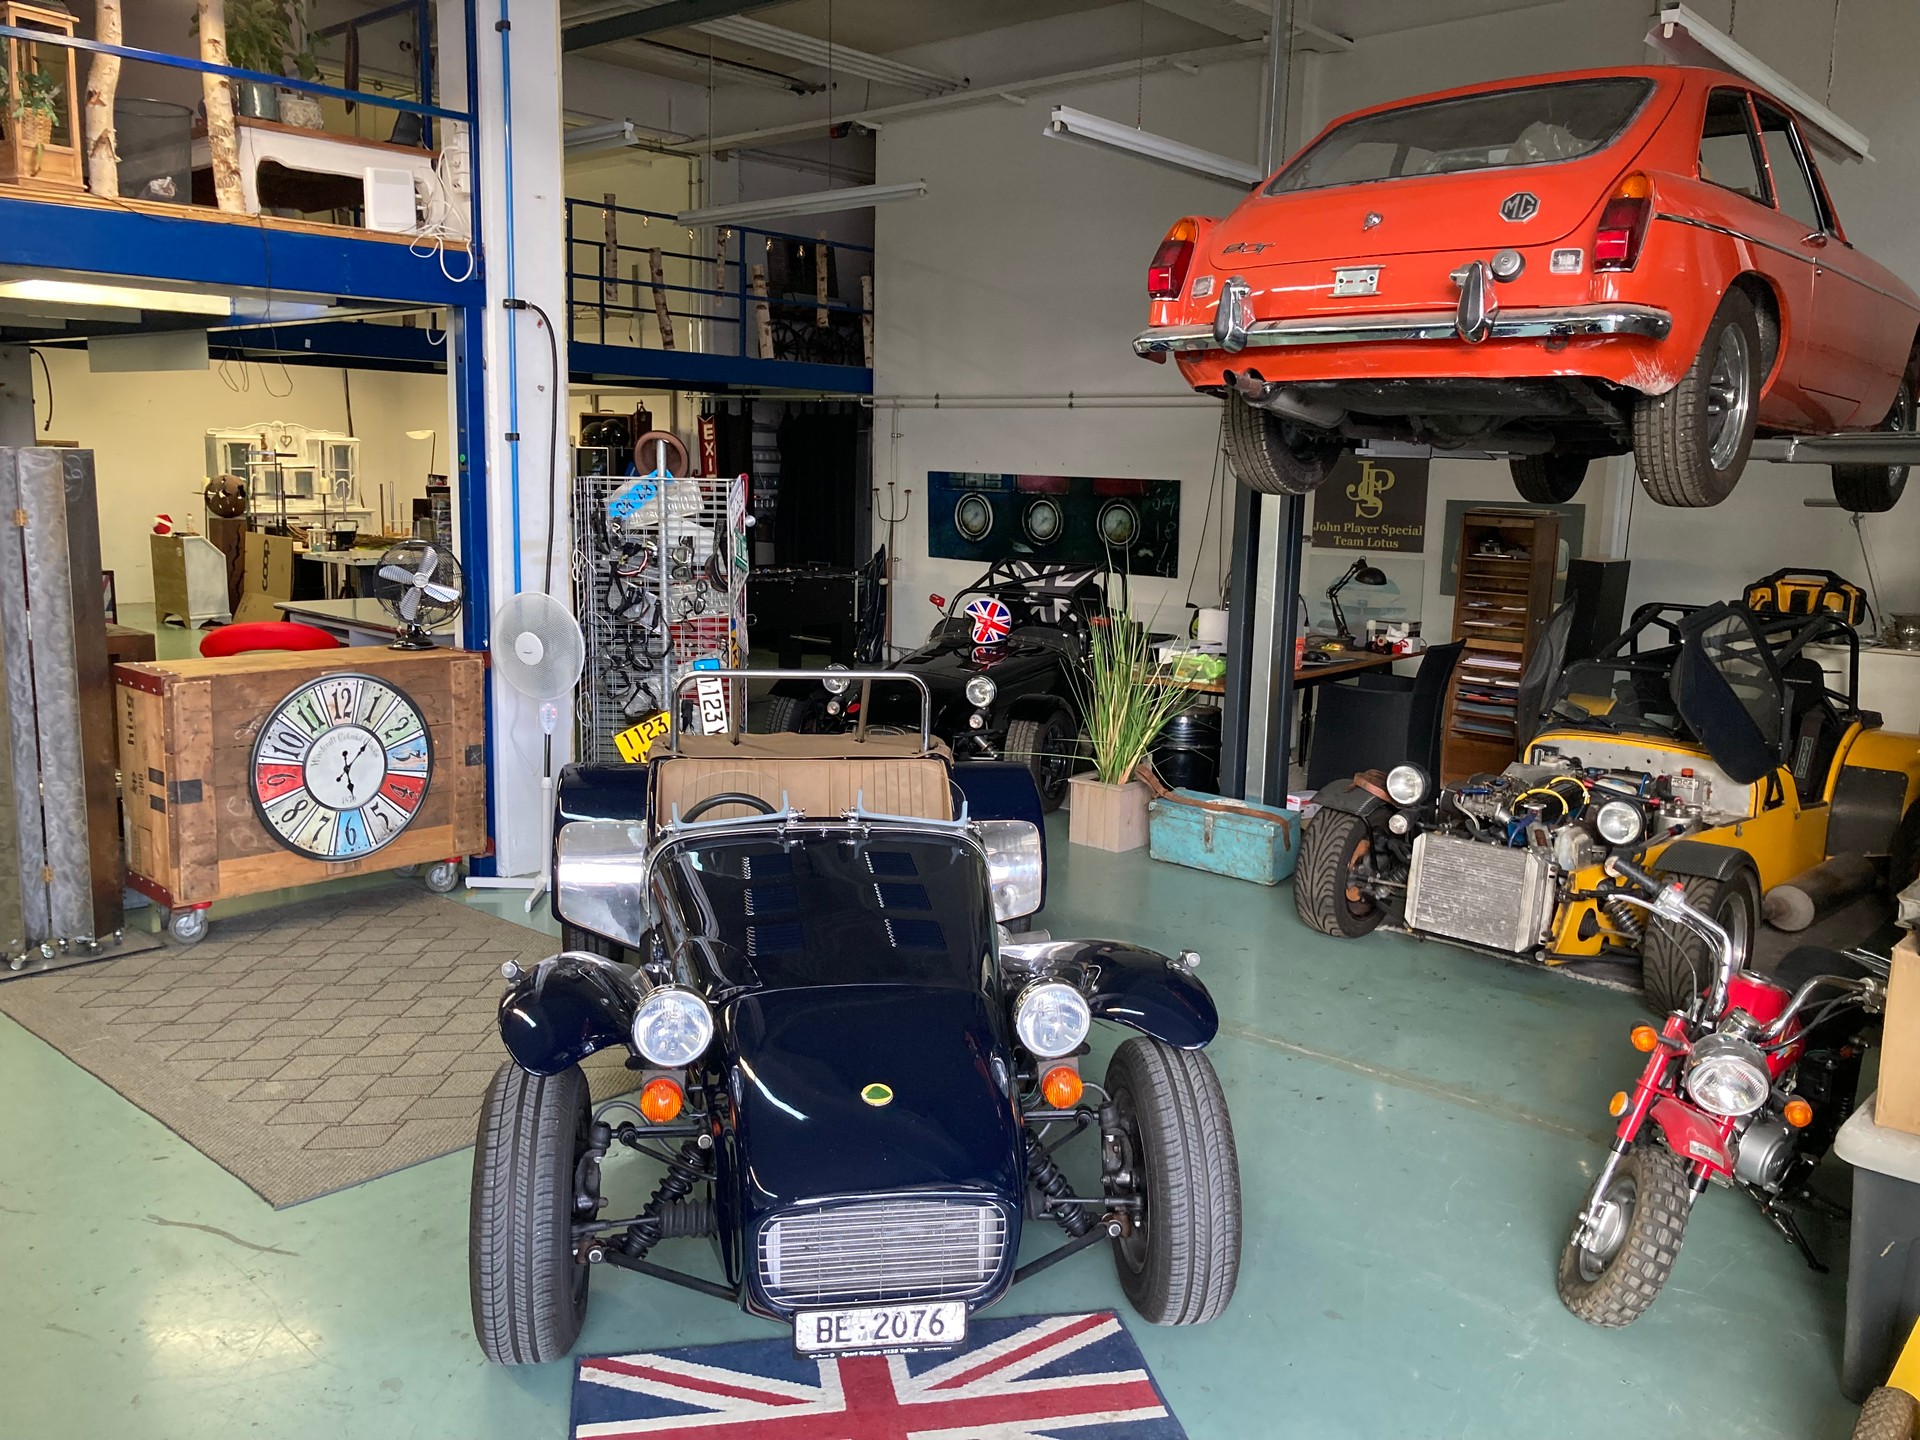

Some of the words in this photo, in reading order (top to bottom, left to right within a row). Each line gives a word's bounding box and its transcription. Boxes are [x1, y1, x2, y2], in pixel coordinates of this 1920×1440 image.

[1504, 195, 1535, 218] MG
[1314, 521, 1341, 532] John
[1344, 522, 1379, 536] Player
[1381, 524, 1423, 536] Special
[1333, 535, 1364, 547] Team
[1367, 537, 1399, 548] Lotus
[262, 539, 270, 591] coop
[297, 699, 326, 733] 11
[332, 688, 353, 720] 12
[364, 694, 382, 723] 1
[382, 716, 409, 740] 2
[622, 715, 669, 751] 1123
[272, 732, 305, 759] 10
[392, 749, 422, 762] 3
[266, 773, 297, 787] 9
[281, 799, 308, 823] 8
[370, 801, 393, 833] 5
[312, 815, 332, 844] 7
[345, 816, 357, 846] 6
